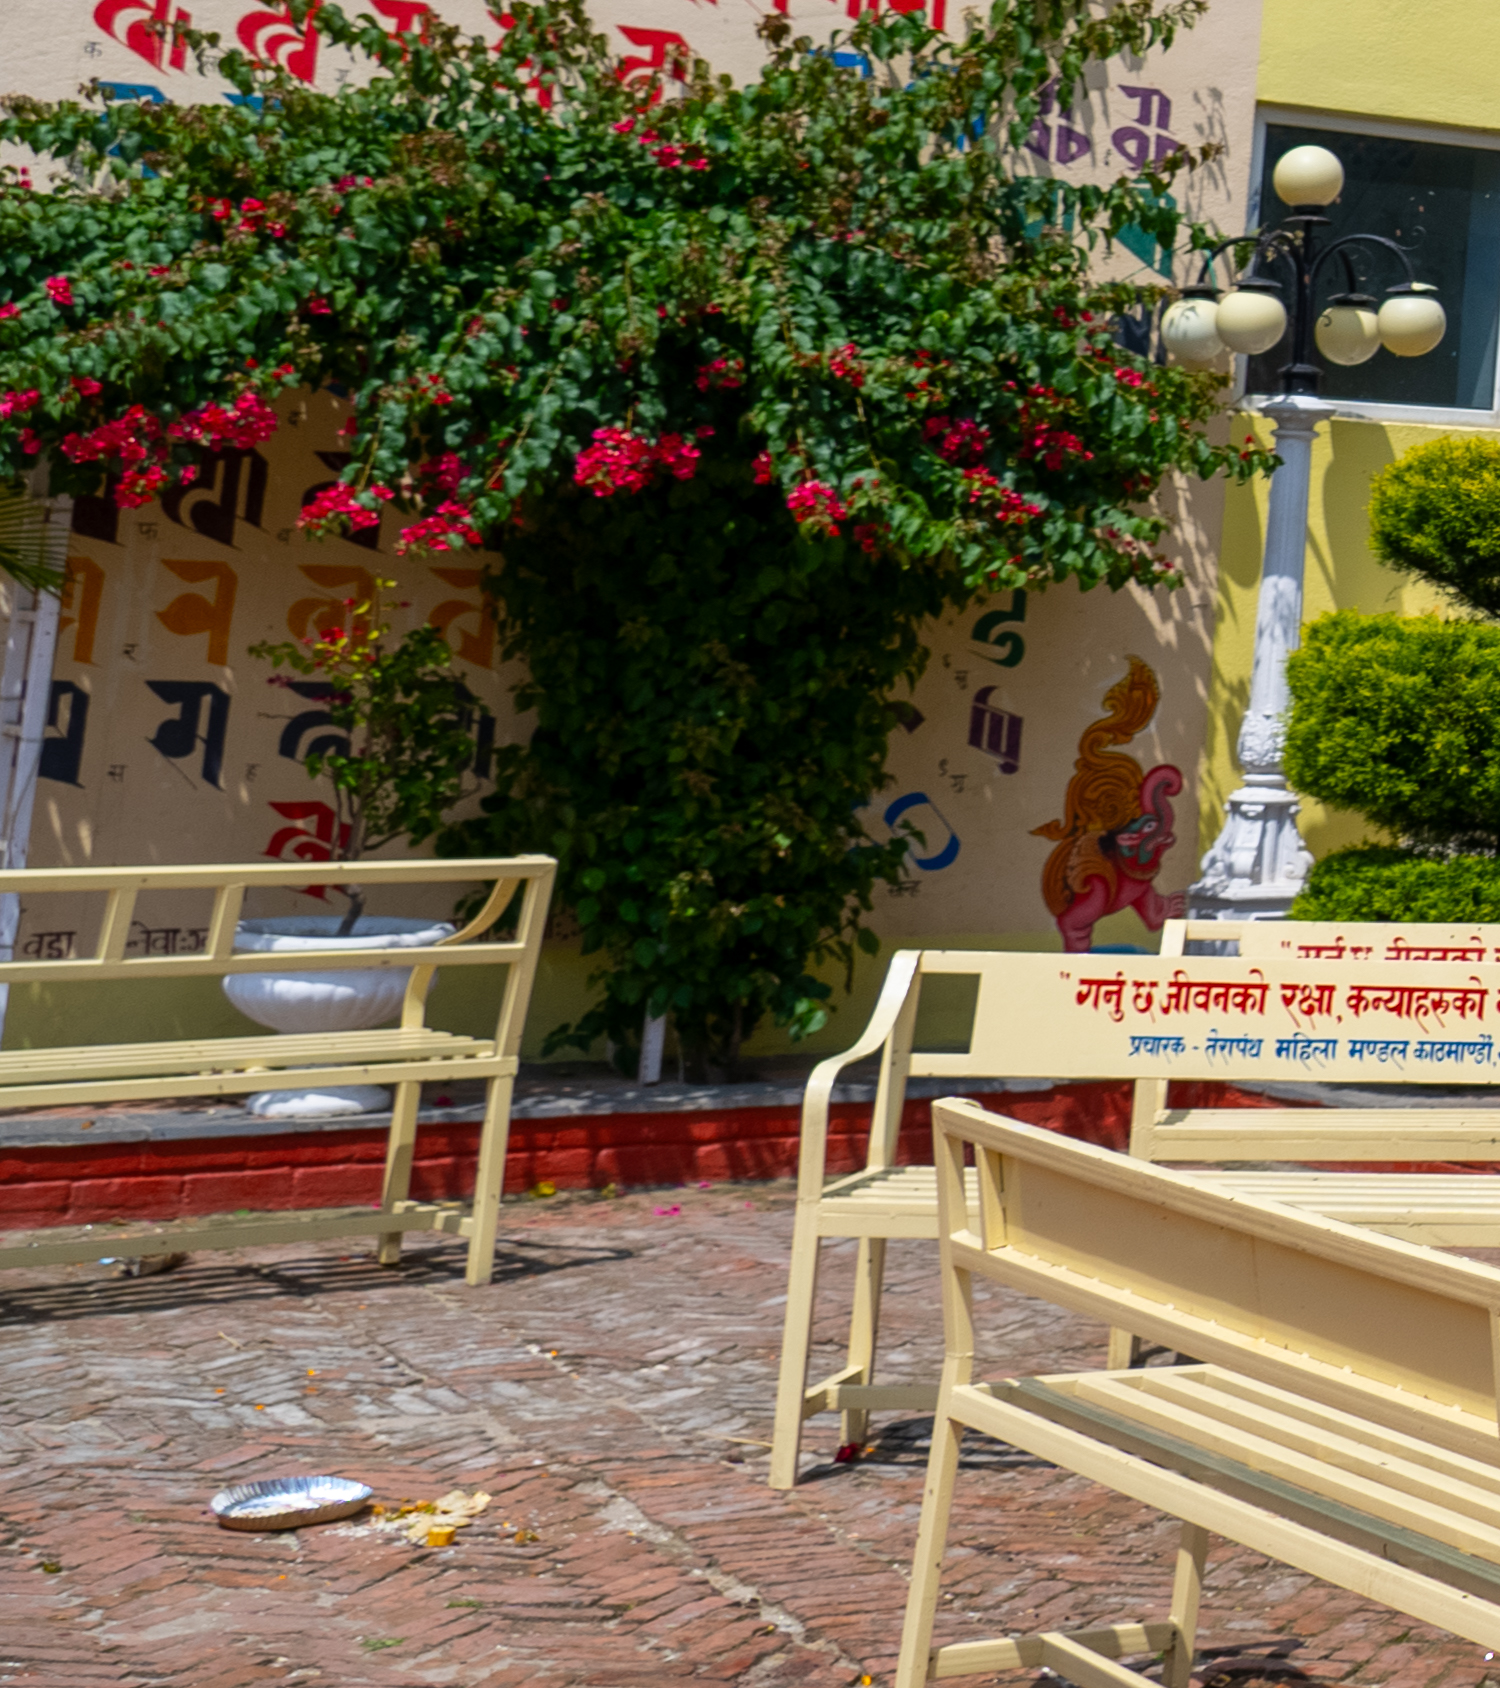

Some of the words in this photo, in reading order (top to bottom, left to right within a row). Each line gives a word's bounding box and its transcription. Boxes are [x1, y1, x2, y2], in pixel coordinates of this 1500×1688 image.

[1160, 969, 1271, 1016] जीवनको
[1128, 1035, 1187, 1064] प्रचारक
[1275, 1032, 1338, 1071] महिला
[1348, 1040, 1411, 1071] मण्डल
